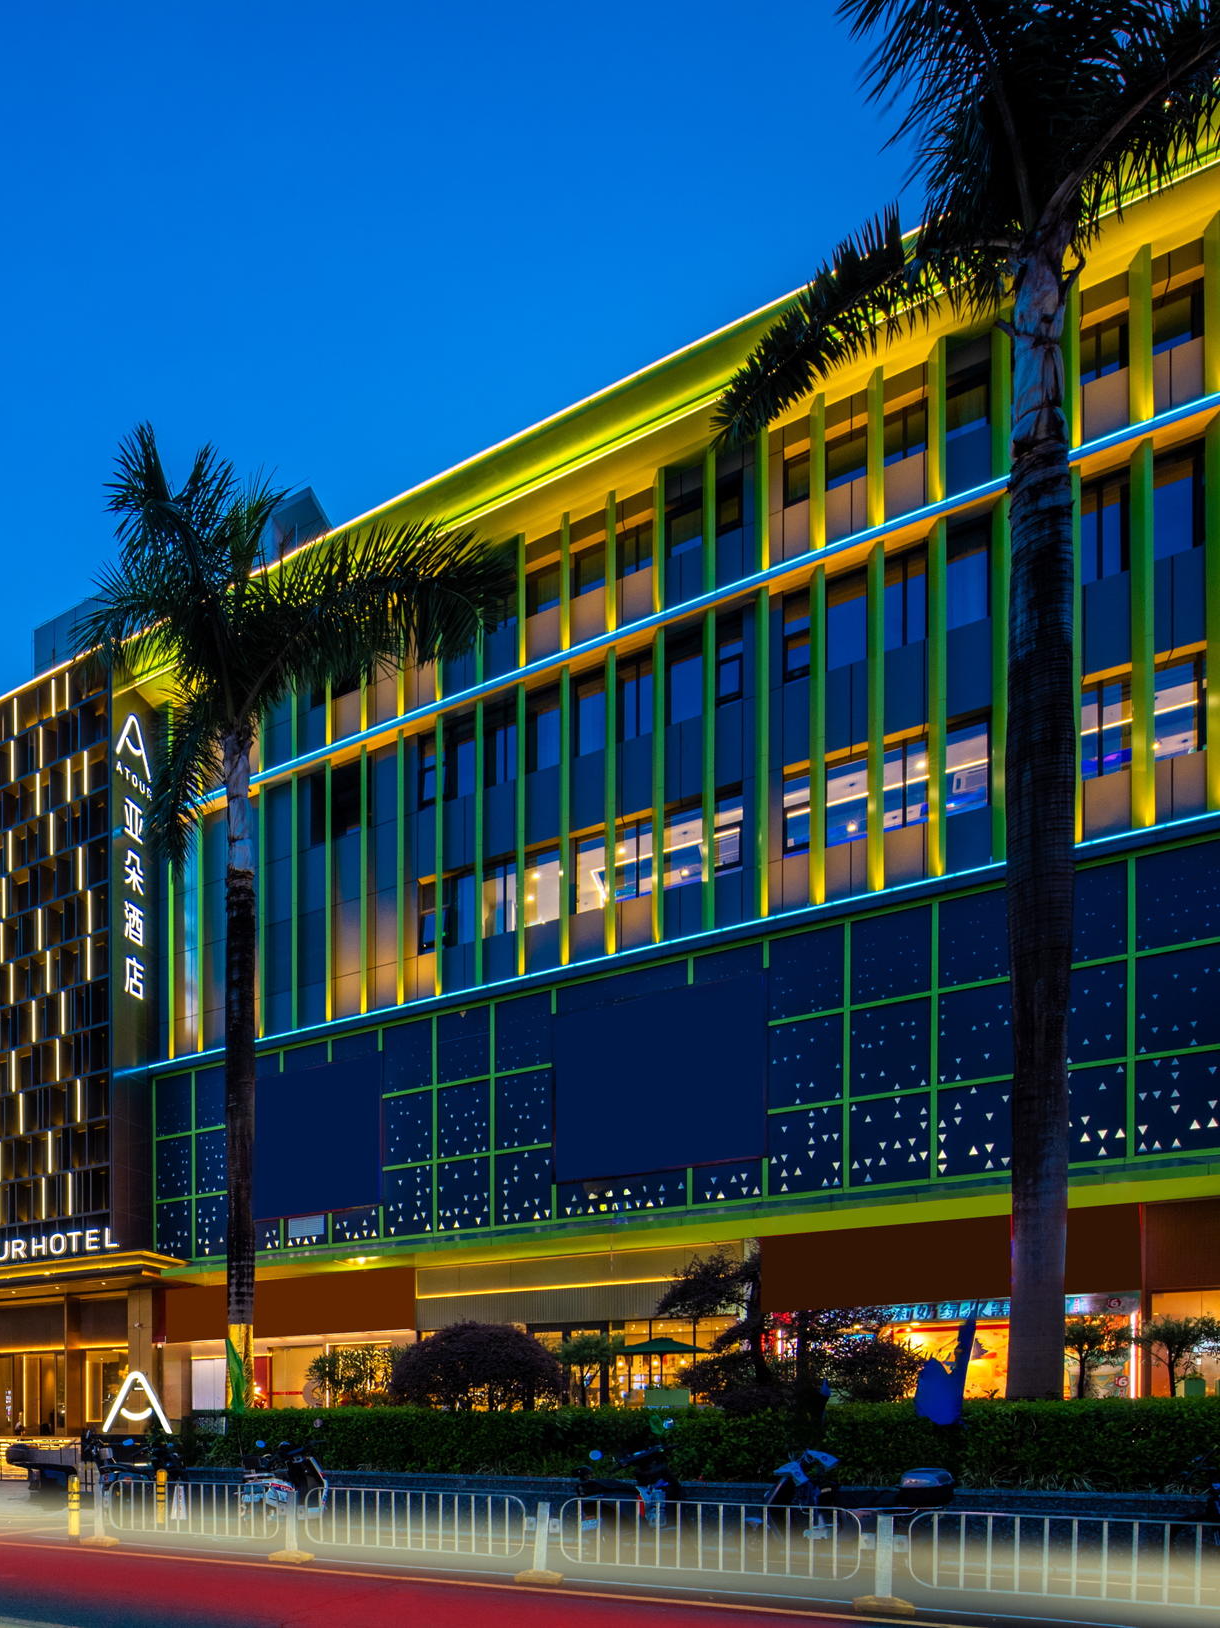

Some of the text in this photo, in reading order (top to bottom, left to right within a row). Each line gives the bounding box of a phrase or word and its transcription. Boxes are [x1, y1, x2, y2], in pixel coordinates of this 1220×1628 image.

[124, 797, 145, 1001] 亚朵酒店
[30, 1227, 120, 1257] HOTEL
